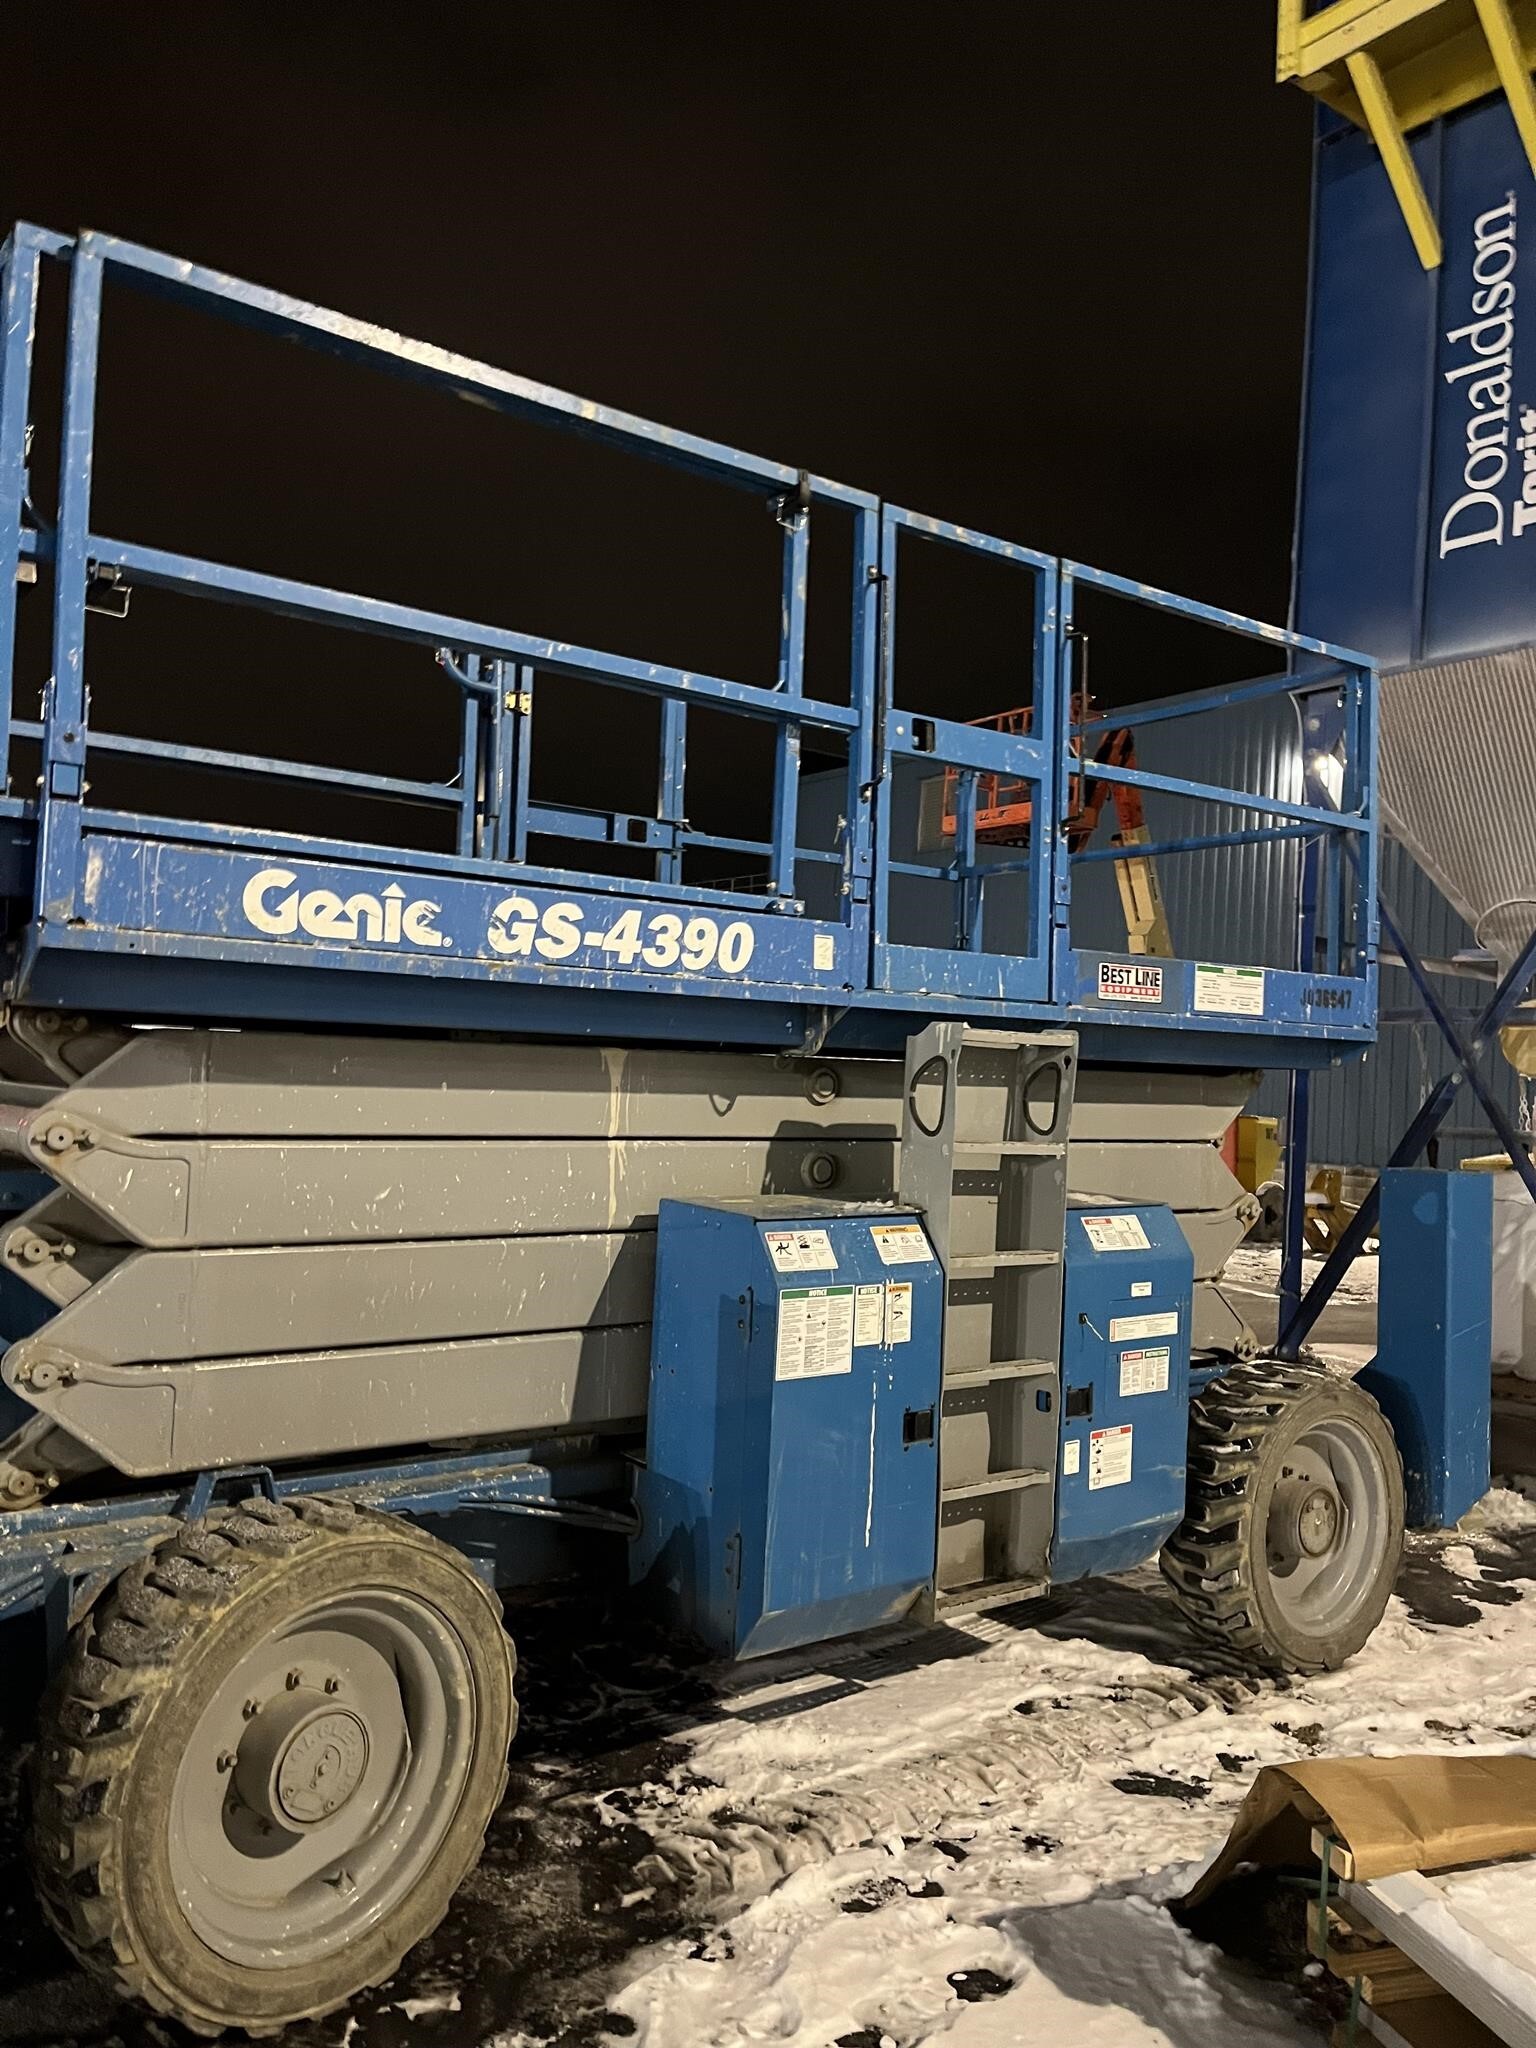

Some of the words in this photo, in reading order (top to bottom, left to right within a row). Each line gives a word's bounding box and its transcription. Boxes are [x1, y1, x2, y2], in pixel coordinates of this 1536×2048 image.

[487, 896, 755, 974] GS-4390
[1101, 964, 1131, 985] BEST
[1135, 967, 1160, 987] LINE
